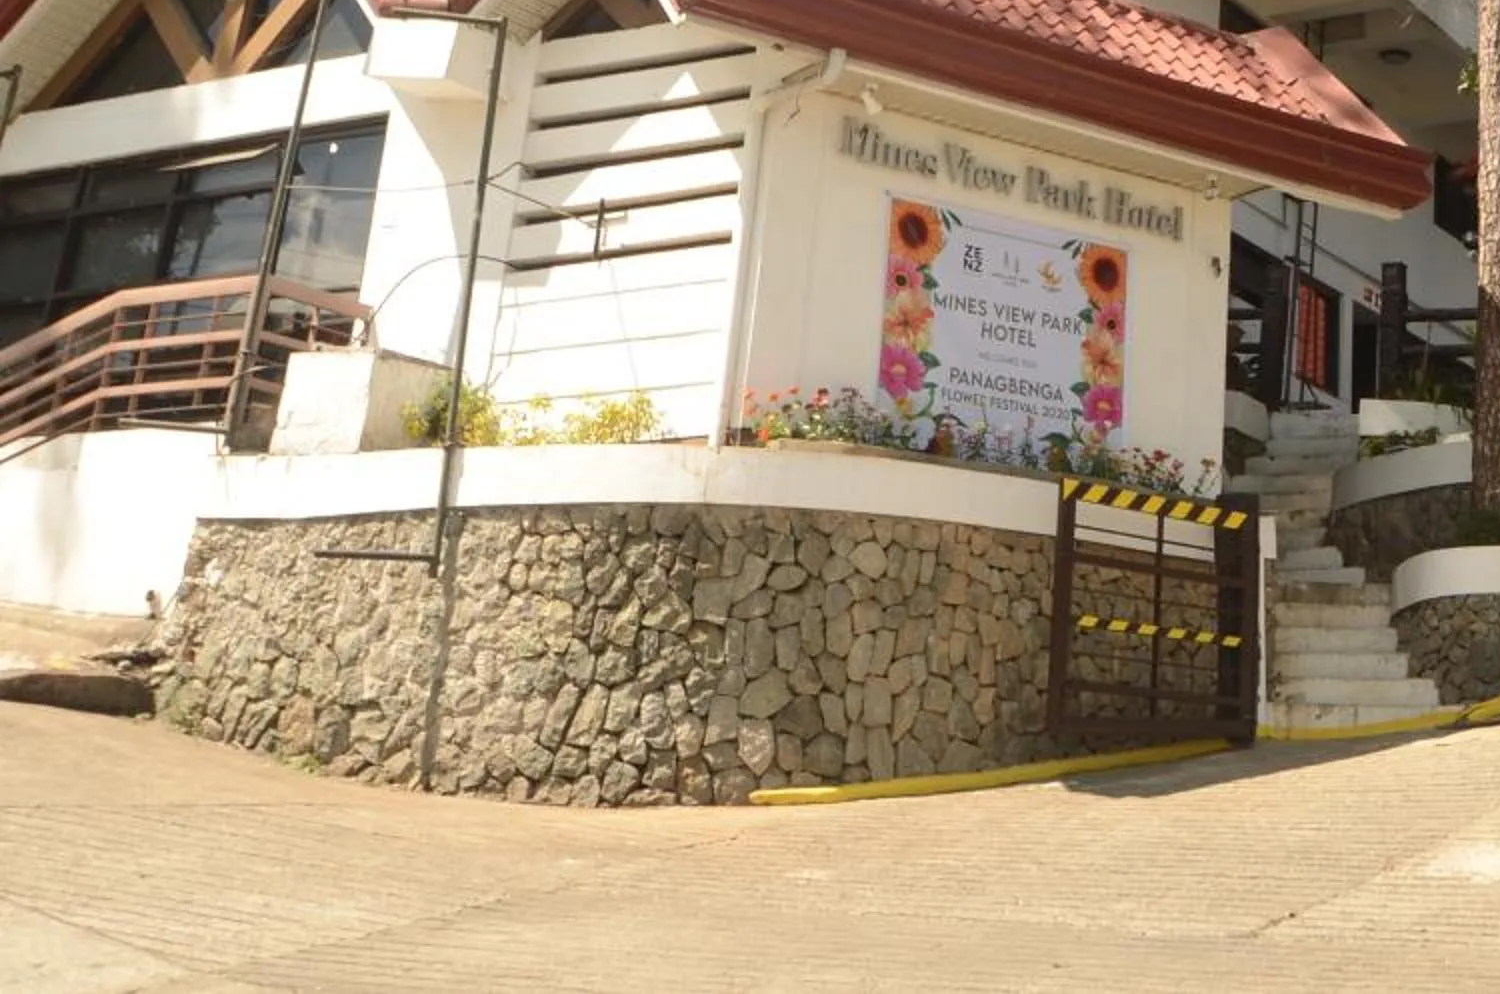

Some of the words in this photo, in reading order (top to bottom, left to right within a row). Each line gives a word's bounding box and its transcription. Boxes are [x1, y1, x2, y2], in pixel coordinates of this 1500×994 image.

[933, 291, 988, 318] MINES
[993, 302, 1036, 327] VIEW
[1040, 310, 1083, 336] PARK
[980, 321, 1037, 348] HOTEL
[949, 366, 1064, 403] PANAGBENGA
